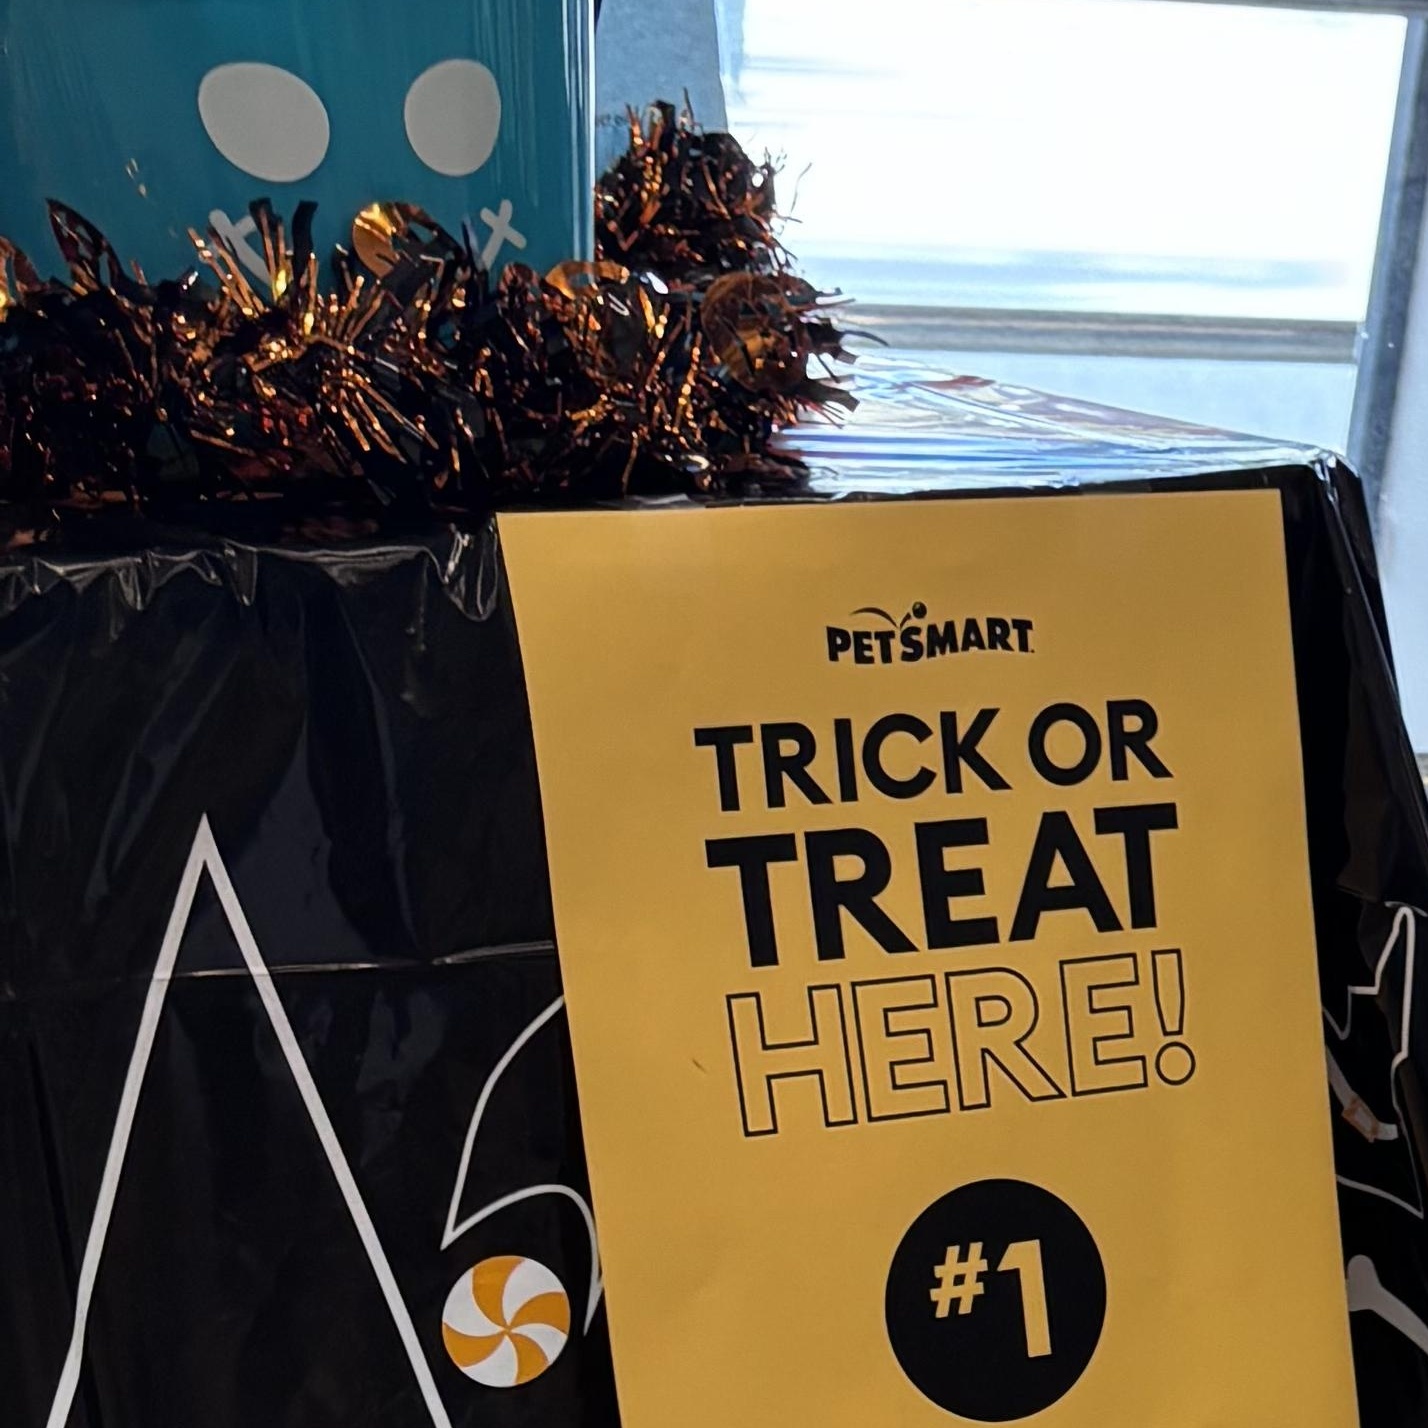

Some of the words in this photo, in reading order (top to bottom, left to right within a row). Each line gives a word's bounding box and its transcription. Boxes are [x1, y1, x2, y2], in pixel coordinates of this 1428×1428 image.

[826, 616, 1035, 666] PETSMART
[693, 707, 1011, 812] TRICK
[1027, 698, 1174, 788] OR
[704, 803, 1178, 968] TREAT
[725, 948, 1197, 1138] HERE!
[929, 1238, 1052, 1358] #1
